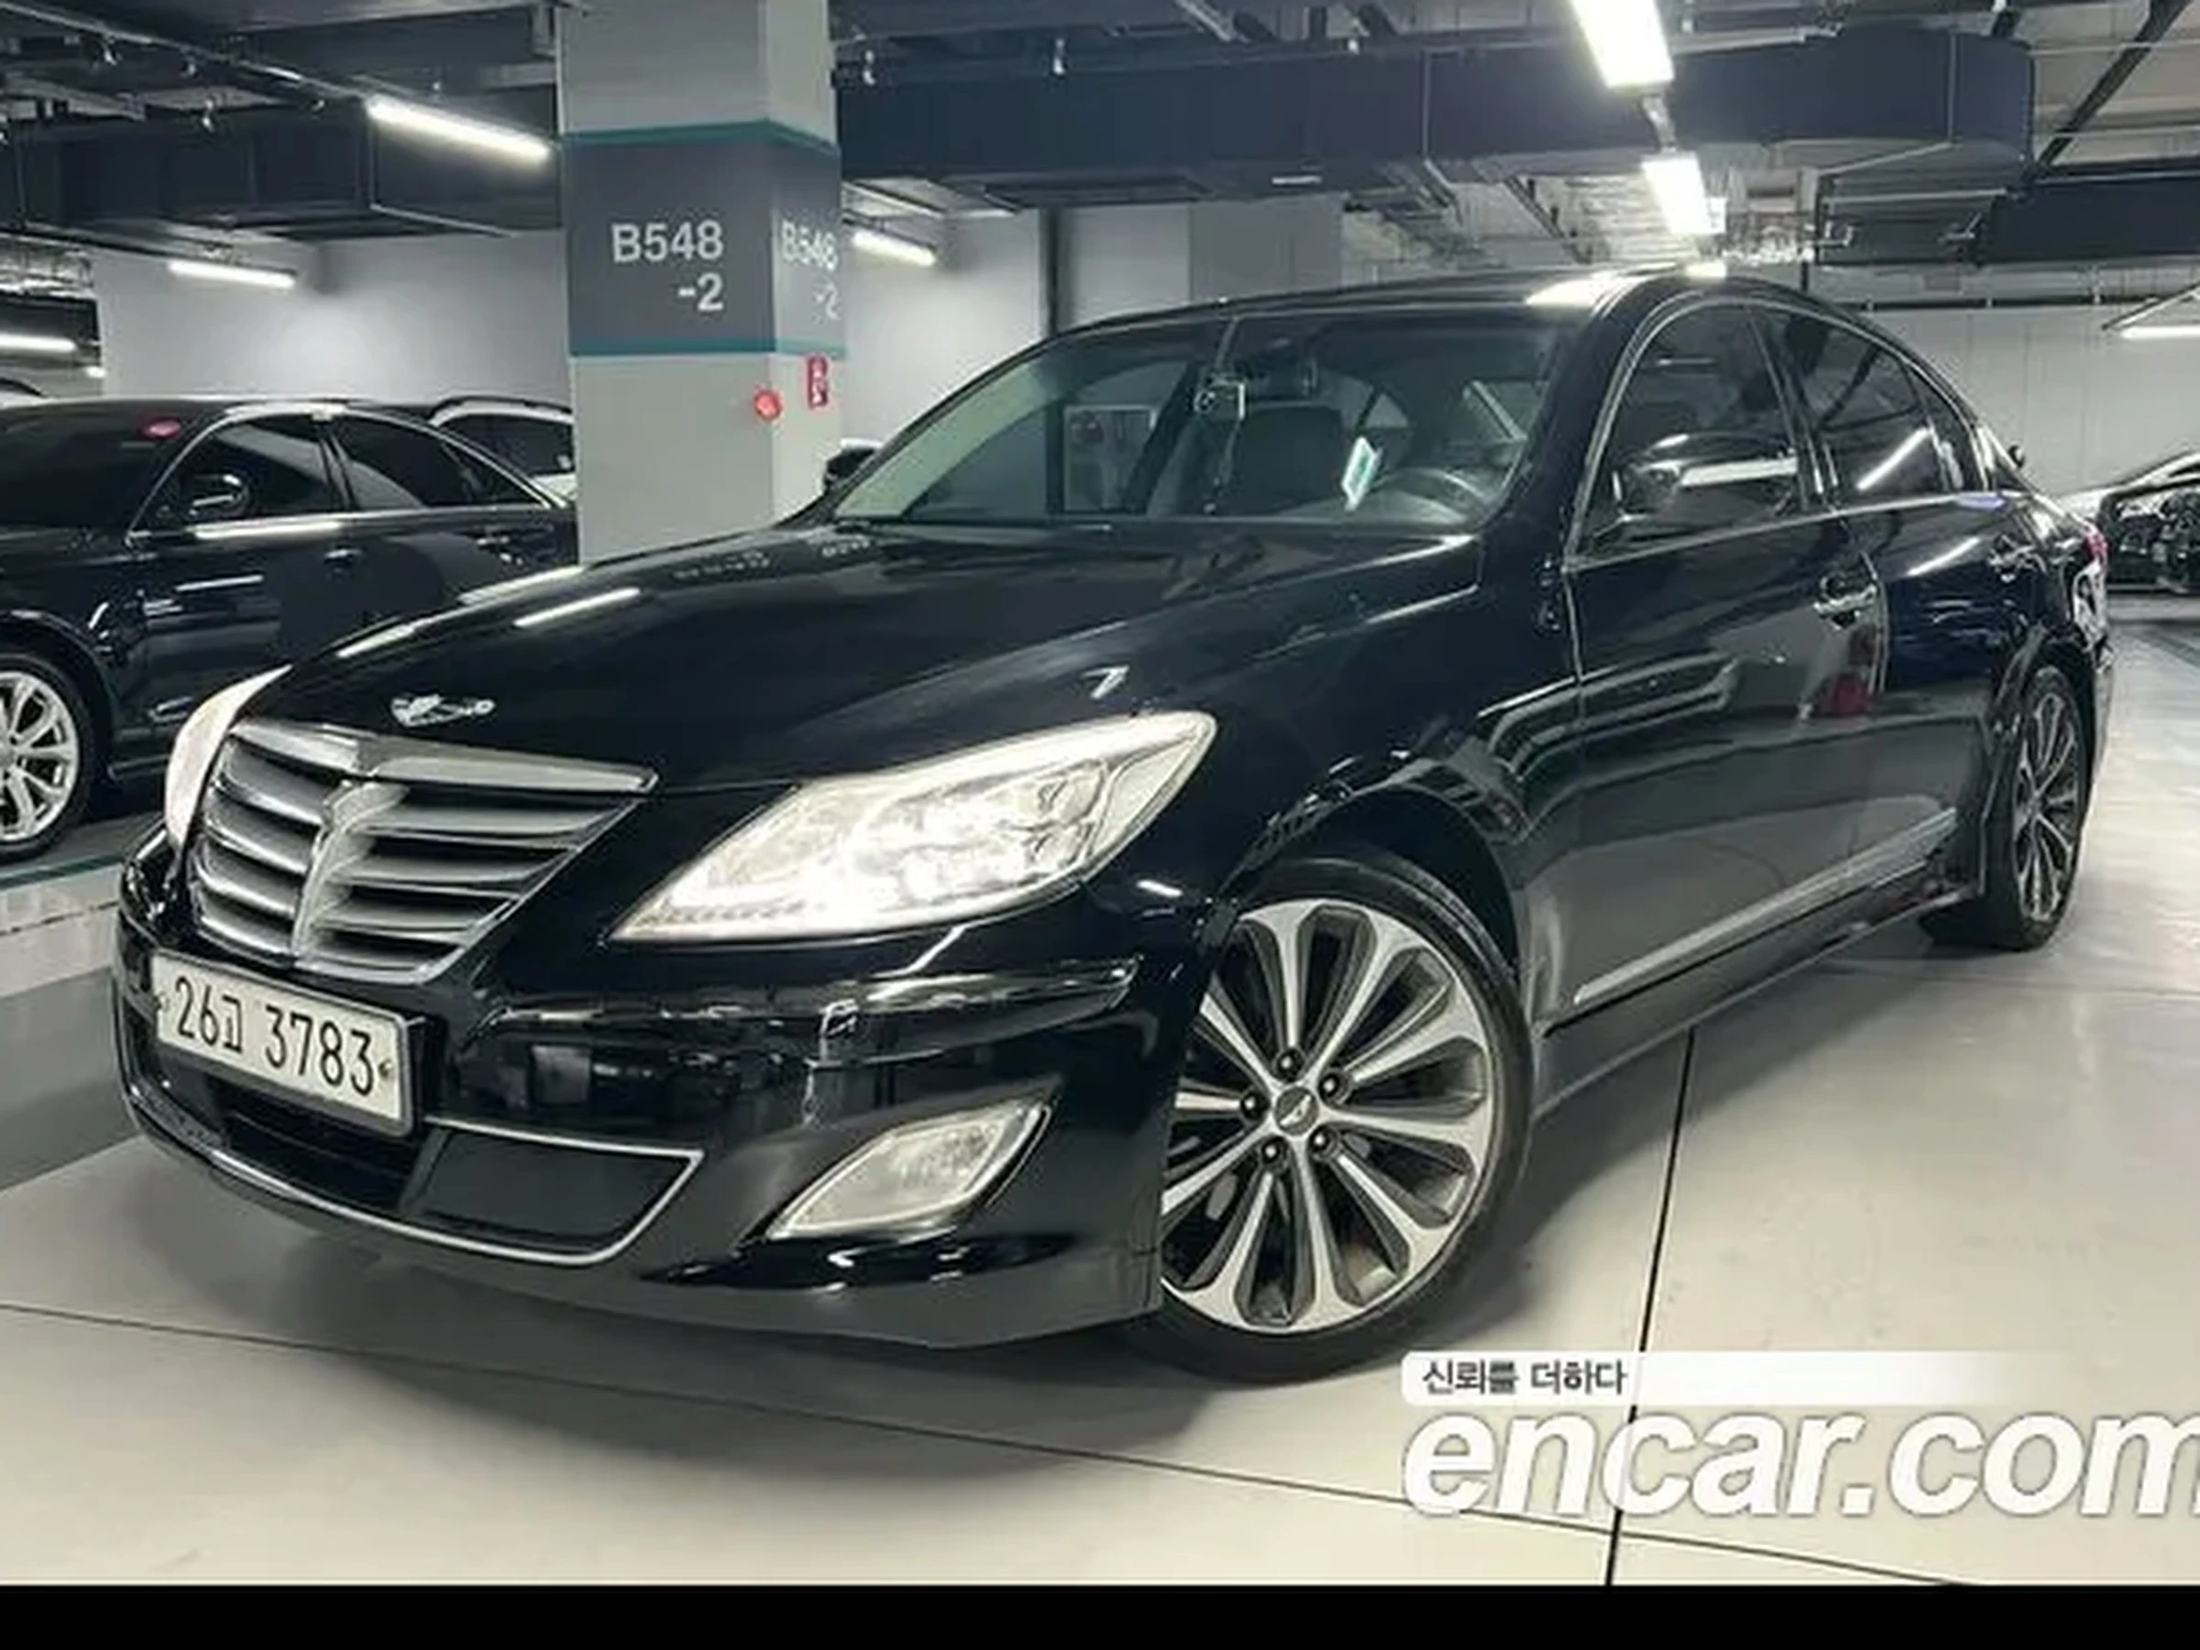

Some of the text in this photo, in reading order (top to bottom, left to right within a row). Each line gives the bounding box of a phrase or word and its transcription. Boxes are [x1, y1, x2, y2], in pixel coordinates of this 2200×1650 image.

[611, 219, 724, 263] B548
[677, 272, 724, 312] -2
[175, 976, 374, 1096] 26고 3783
